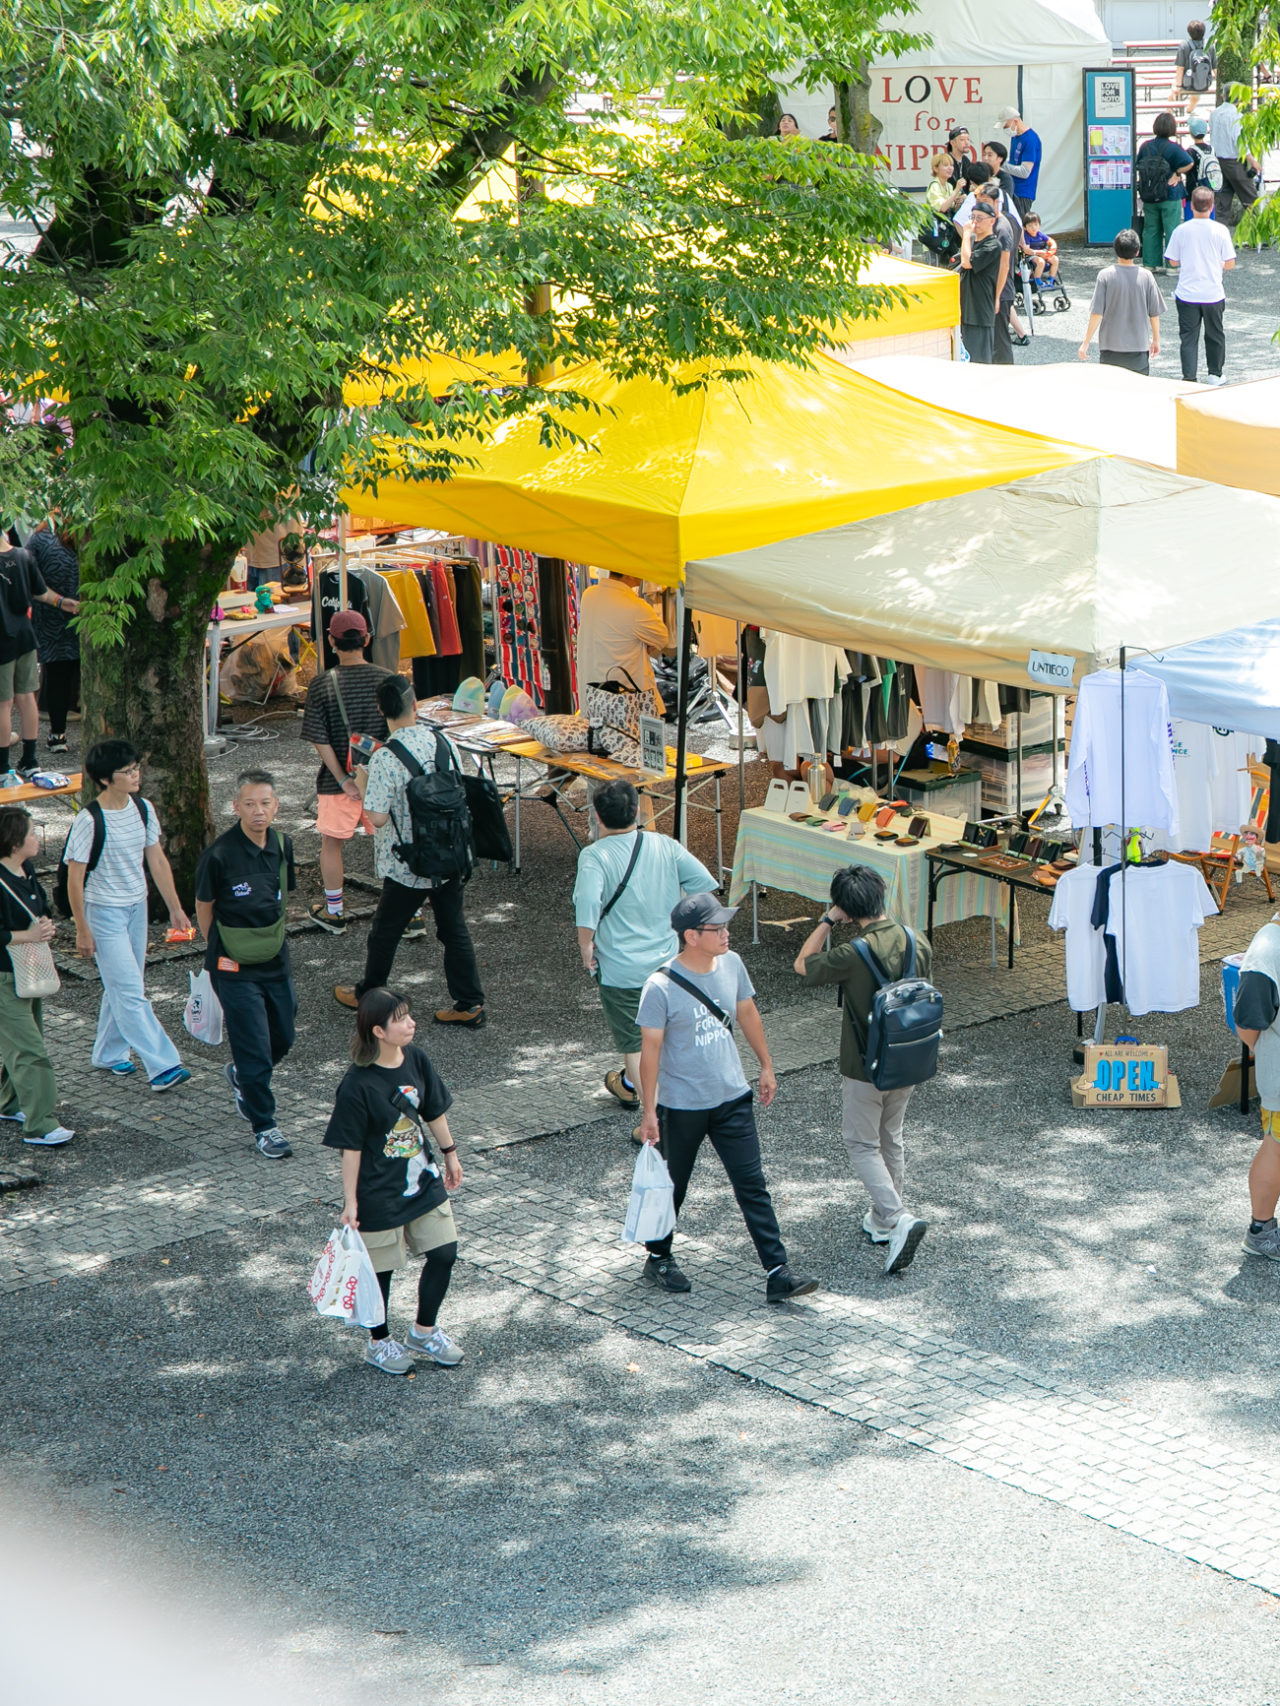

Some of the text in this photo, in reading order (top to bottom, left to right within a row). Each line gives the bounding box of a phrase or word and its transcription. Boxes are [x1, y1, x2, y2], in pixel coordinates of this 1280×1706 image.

[882, 75, 984, 104] LOVE
[914, 110, 956, 132] for
[1096, 1059, 1155, 1091] OPEN
[1096, 1093, 1156, 1102] CHEAP TIMES
